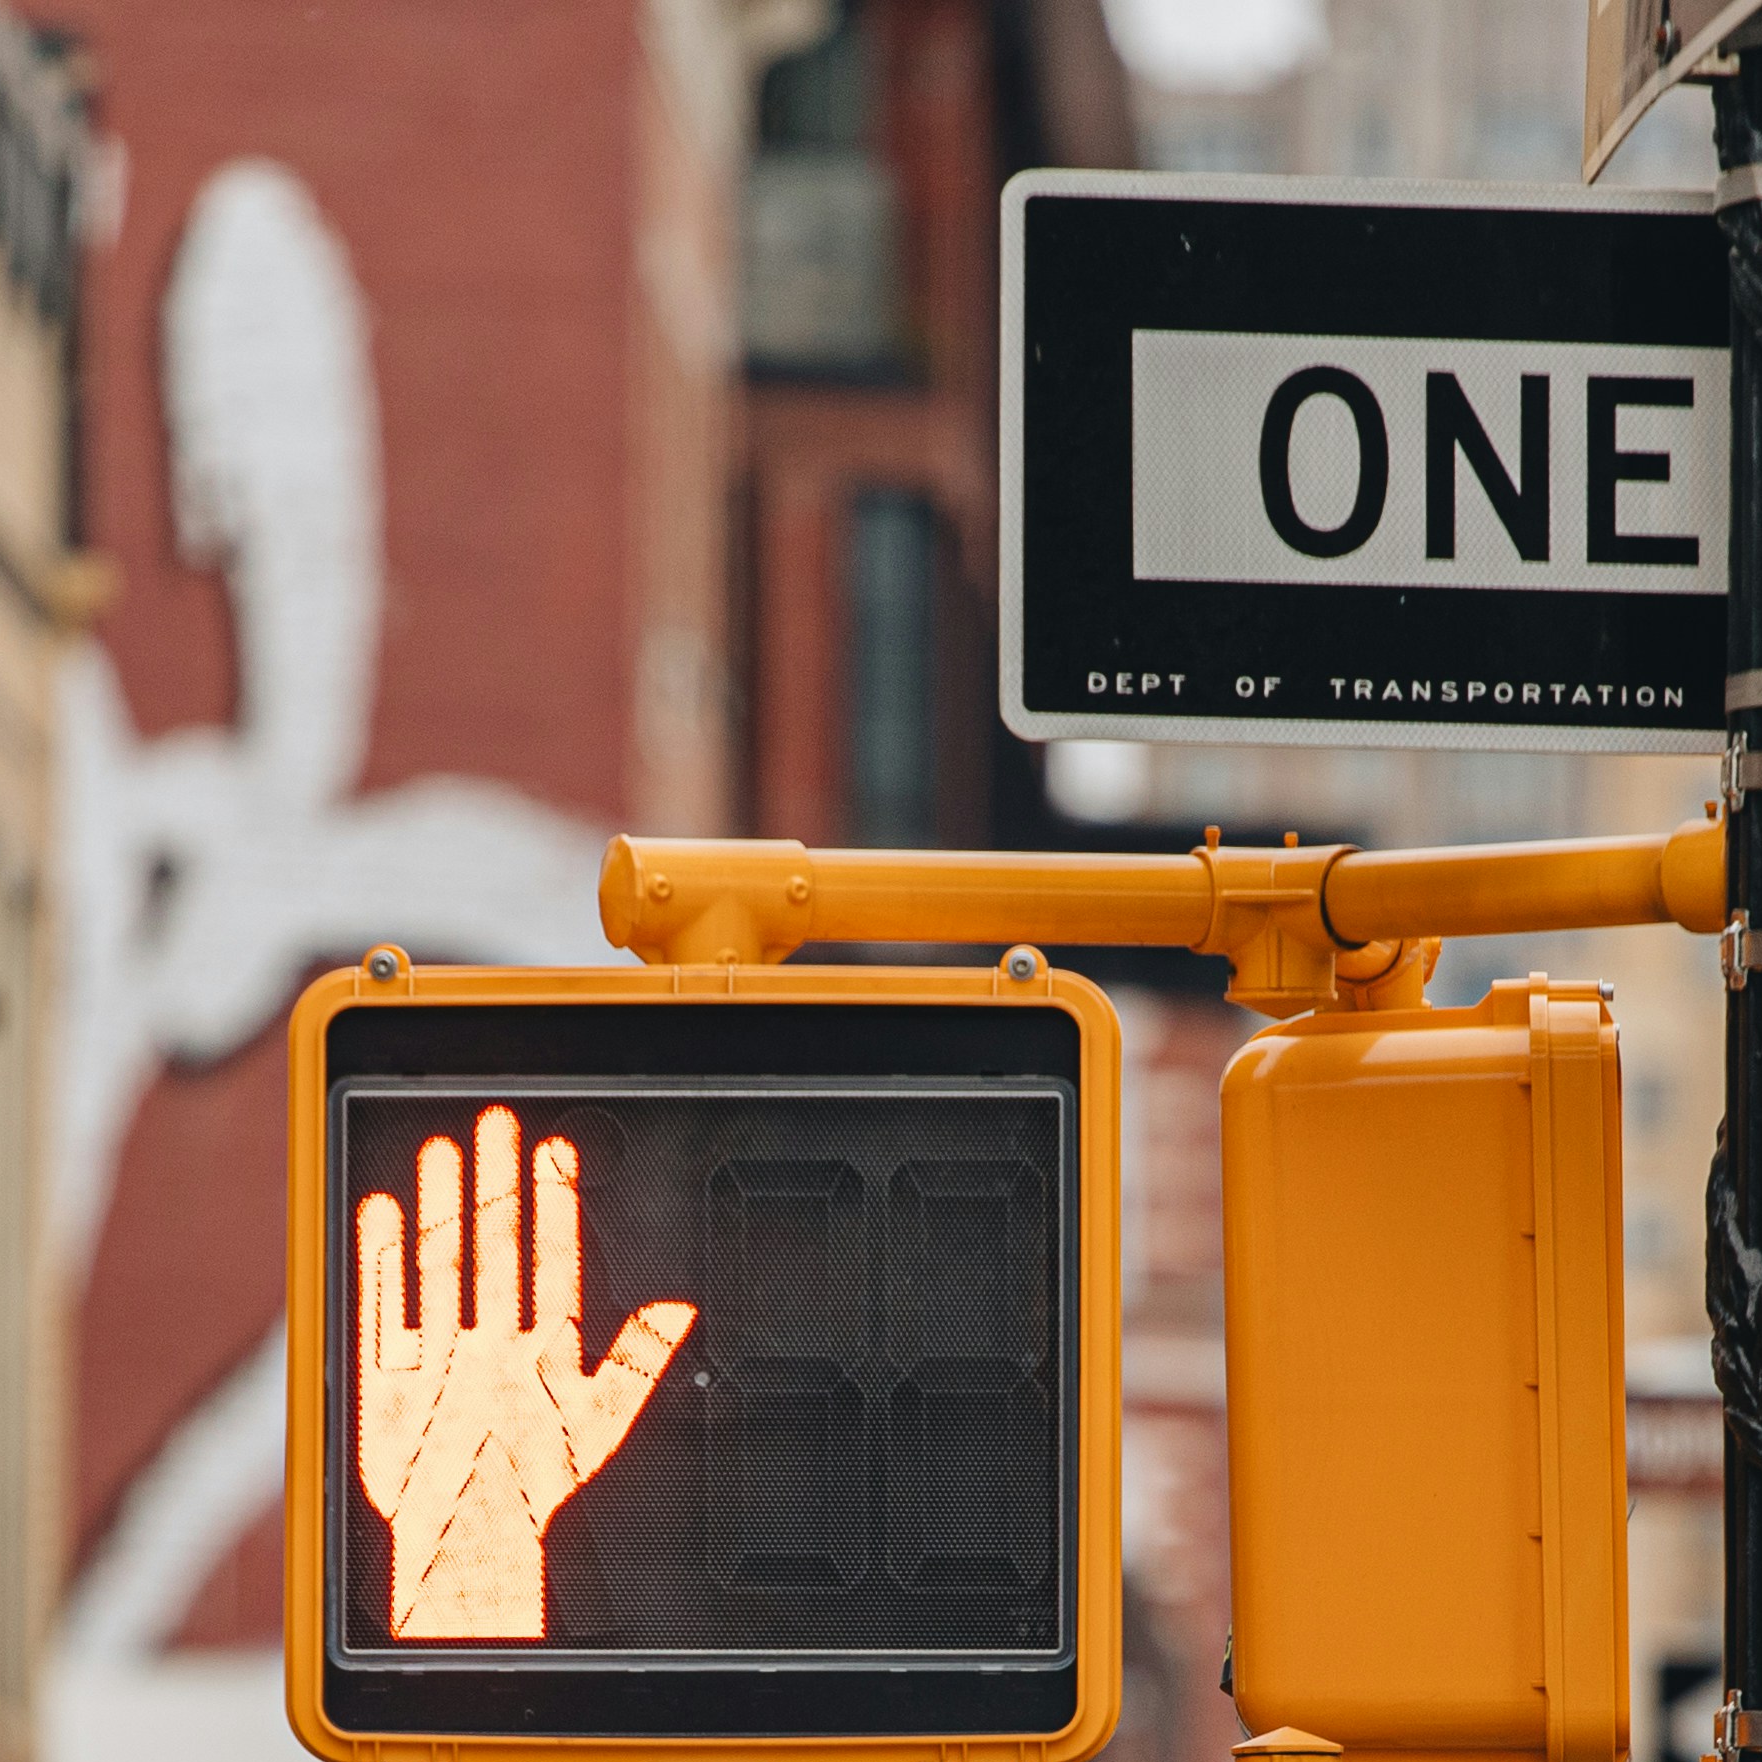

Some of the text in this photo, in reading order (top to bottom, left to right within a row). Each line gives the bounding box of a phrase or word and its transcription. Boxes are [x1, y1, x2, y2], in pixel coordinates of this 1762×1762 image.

[1258, 365, 1700, 567] ONE
[1087, 671, 1686, 709] DEPT OF TRANSPORTATION
